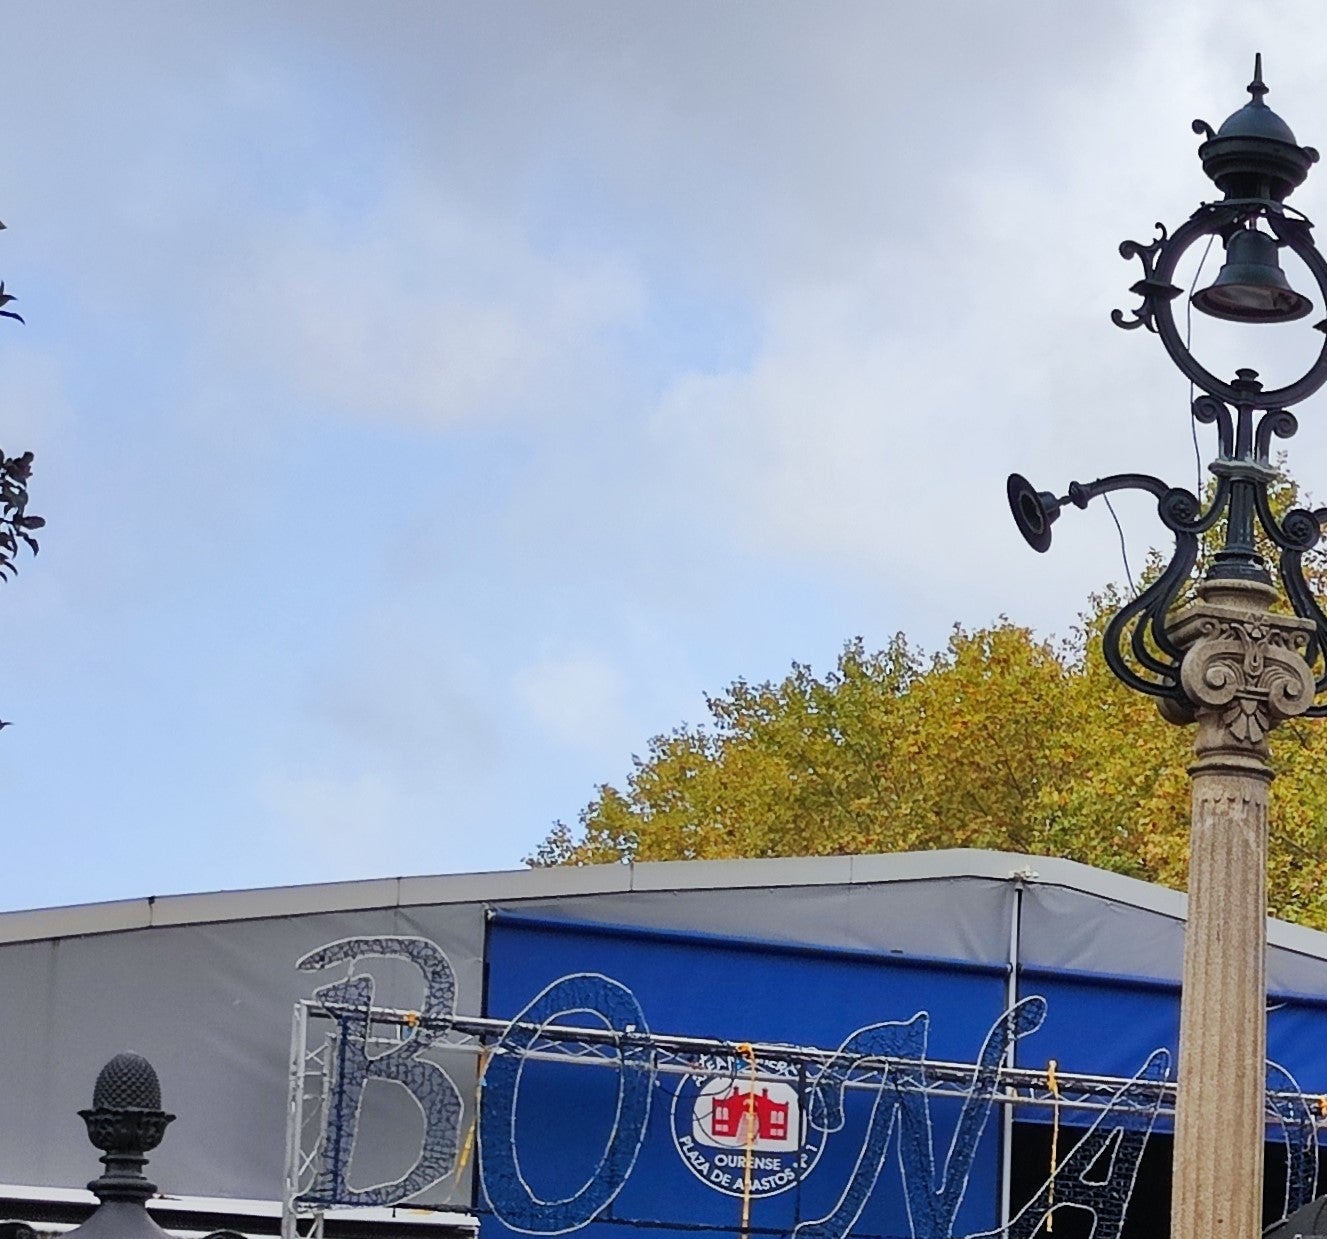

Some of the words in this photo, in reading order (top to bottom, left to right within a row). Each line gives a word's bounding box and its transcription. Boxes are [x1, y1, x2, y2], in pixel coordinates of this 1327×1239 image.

[679, 1135, 710, 1176] PLAZA
[710, 1170, 732, 1187] DE
[733, 1167, 796, 1192] AASTOS
[714, 1154, 781, 1171] OURENSE
